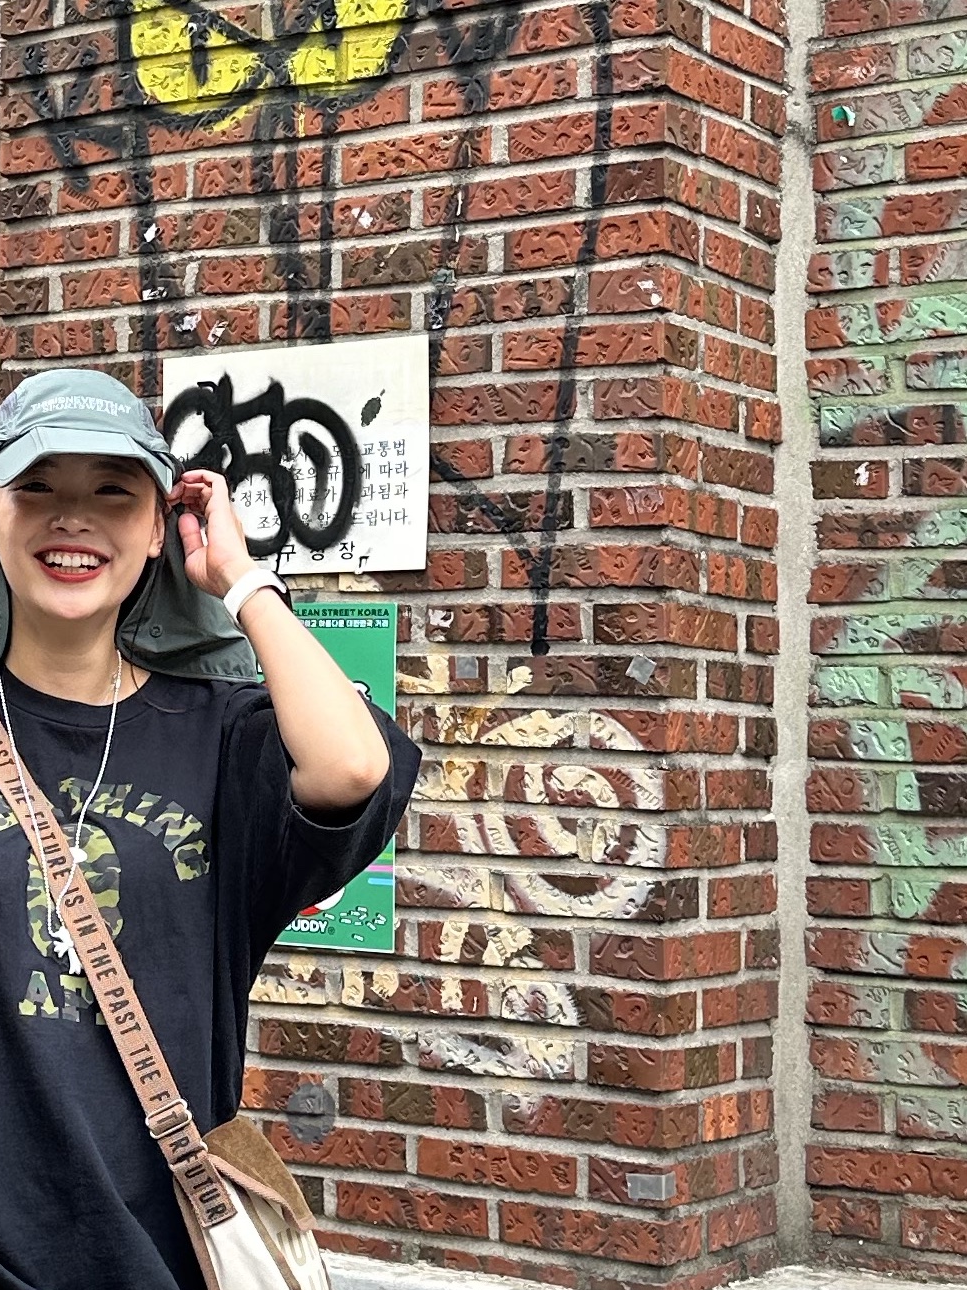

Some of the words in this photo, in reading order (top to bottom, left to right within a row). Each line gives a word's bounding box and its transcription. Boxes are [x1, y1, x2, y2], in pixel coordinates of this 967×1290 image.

[379, 460, 409, 479] 따라
[321, 608, 356, 617] STREET
[357, 608, 390, 617] KOREA
[25, 810, 73, 881] FUTURE
[64, 886, 85, 909] IS
[72, 914, 98, 938] IN
[86, 942, 118, 982] THE
[104, 986, 143, 1036] PAST
[129, 1043, 162, 1086] THE
